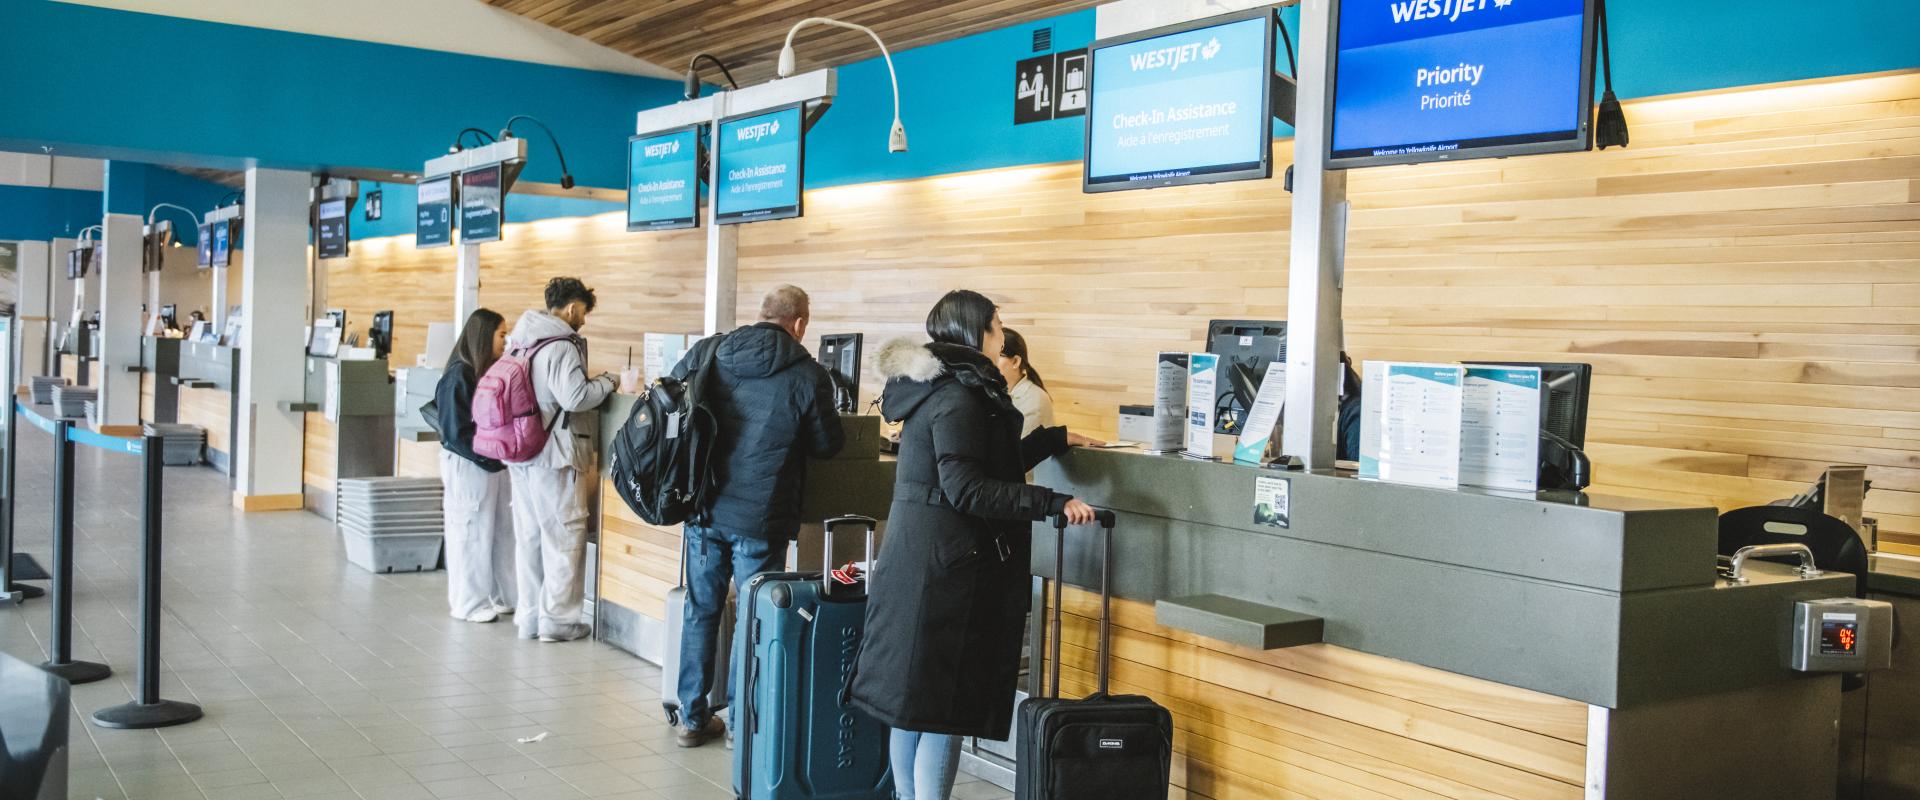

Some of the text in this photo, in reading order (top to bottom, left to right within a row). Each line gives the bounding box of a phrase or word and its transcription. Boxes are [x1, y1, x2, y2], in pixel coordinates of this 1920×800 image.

[1130, 43, 1202, 71] WESTJET
[1416, 62, 1484, 87] Priority
[1421, 90, 1471, 110] Priorité
[1113, 101, 1237, 129] Check-In Assistance
[737, 122, 771, 142] WESTJET
[1119, 133, 1138, 147] Aide
[1148, 124, 1230, 145] l'enregistrement
[645, 142, 673, 159] WESTJET
[754, 164, 786, 177] Assistance
[837, 712, 854, 769] GEAR
